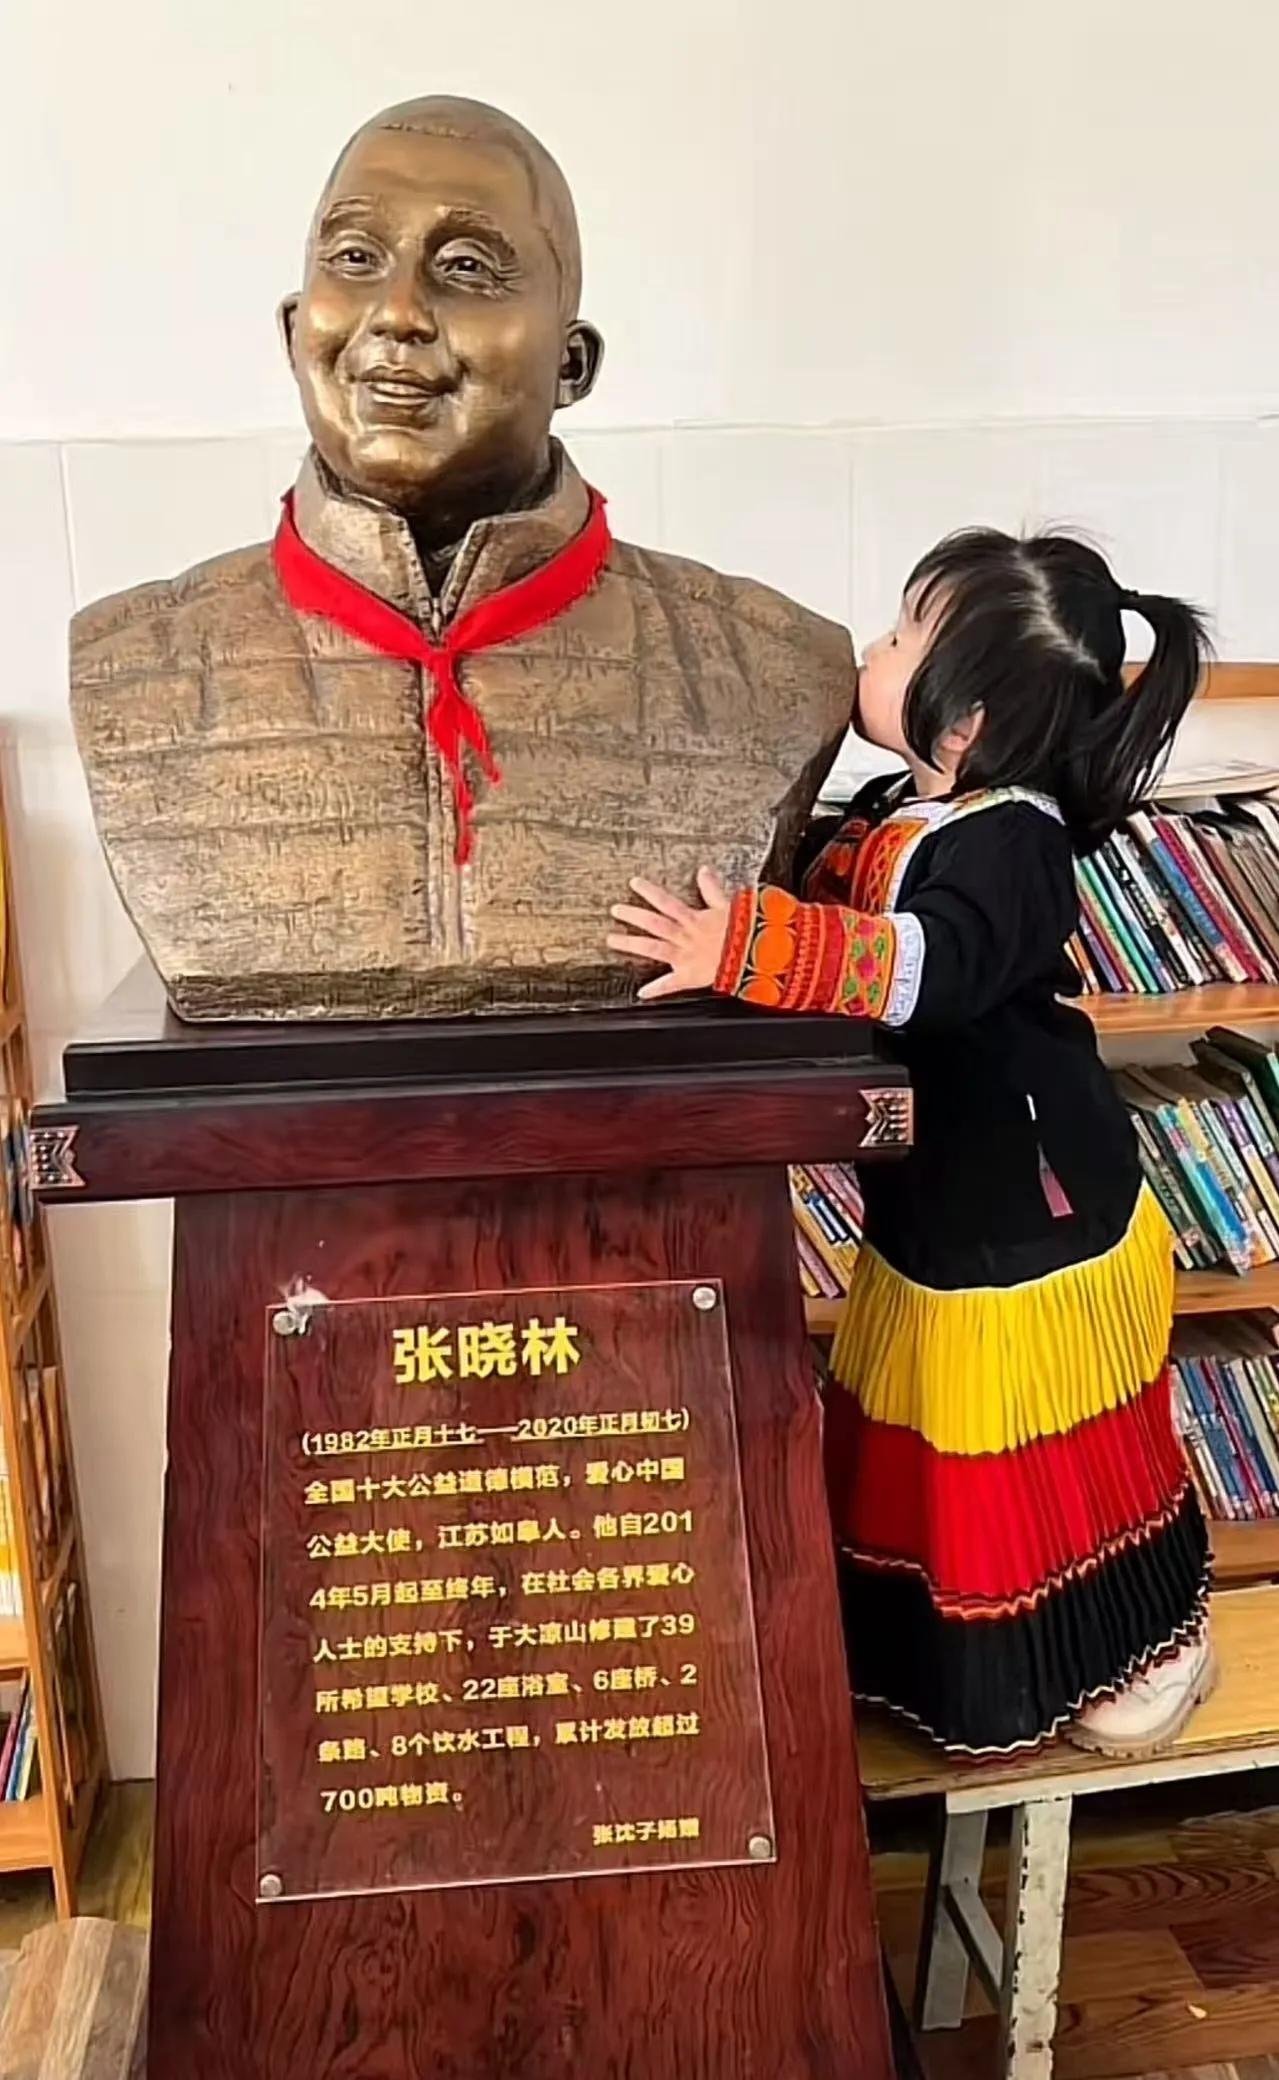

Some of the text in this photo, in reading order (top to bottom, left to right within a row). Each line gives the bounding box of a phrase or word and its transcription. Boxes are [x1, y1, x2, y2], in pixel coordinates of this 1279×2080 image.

[392, 1316, 580, 1384] 张晓林
[304, 1457, 685, 1505] 全国十大公益道德模范，爱心中国
[306, 1509, 692, 1559] 公益大使，江苏如皋人。他自201
[313, 1613, 695, 1664] 人士的支持下，于大凉山修建了39
[316, 1663, 697, 1713] 所希望学校、22座浴室、6座桥、2
[318, 1711, 700, 1763] 条路、8个饮水工程，累计发放超过
[320, 1781, 463, 1813] 700吨物资。
